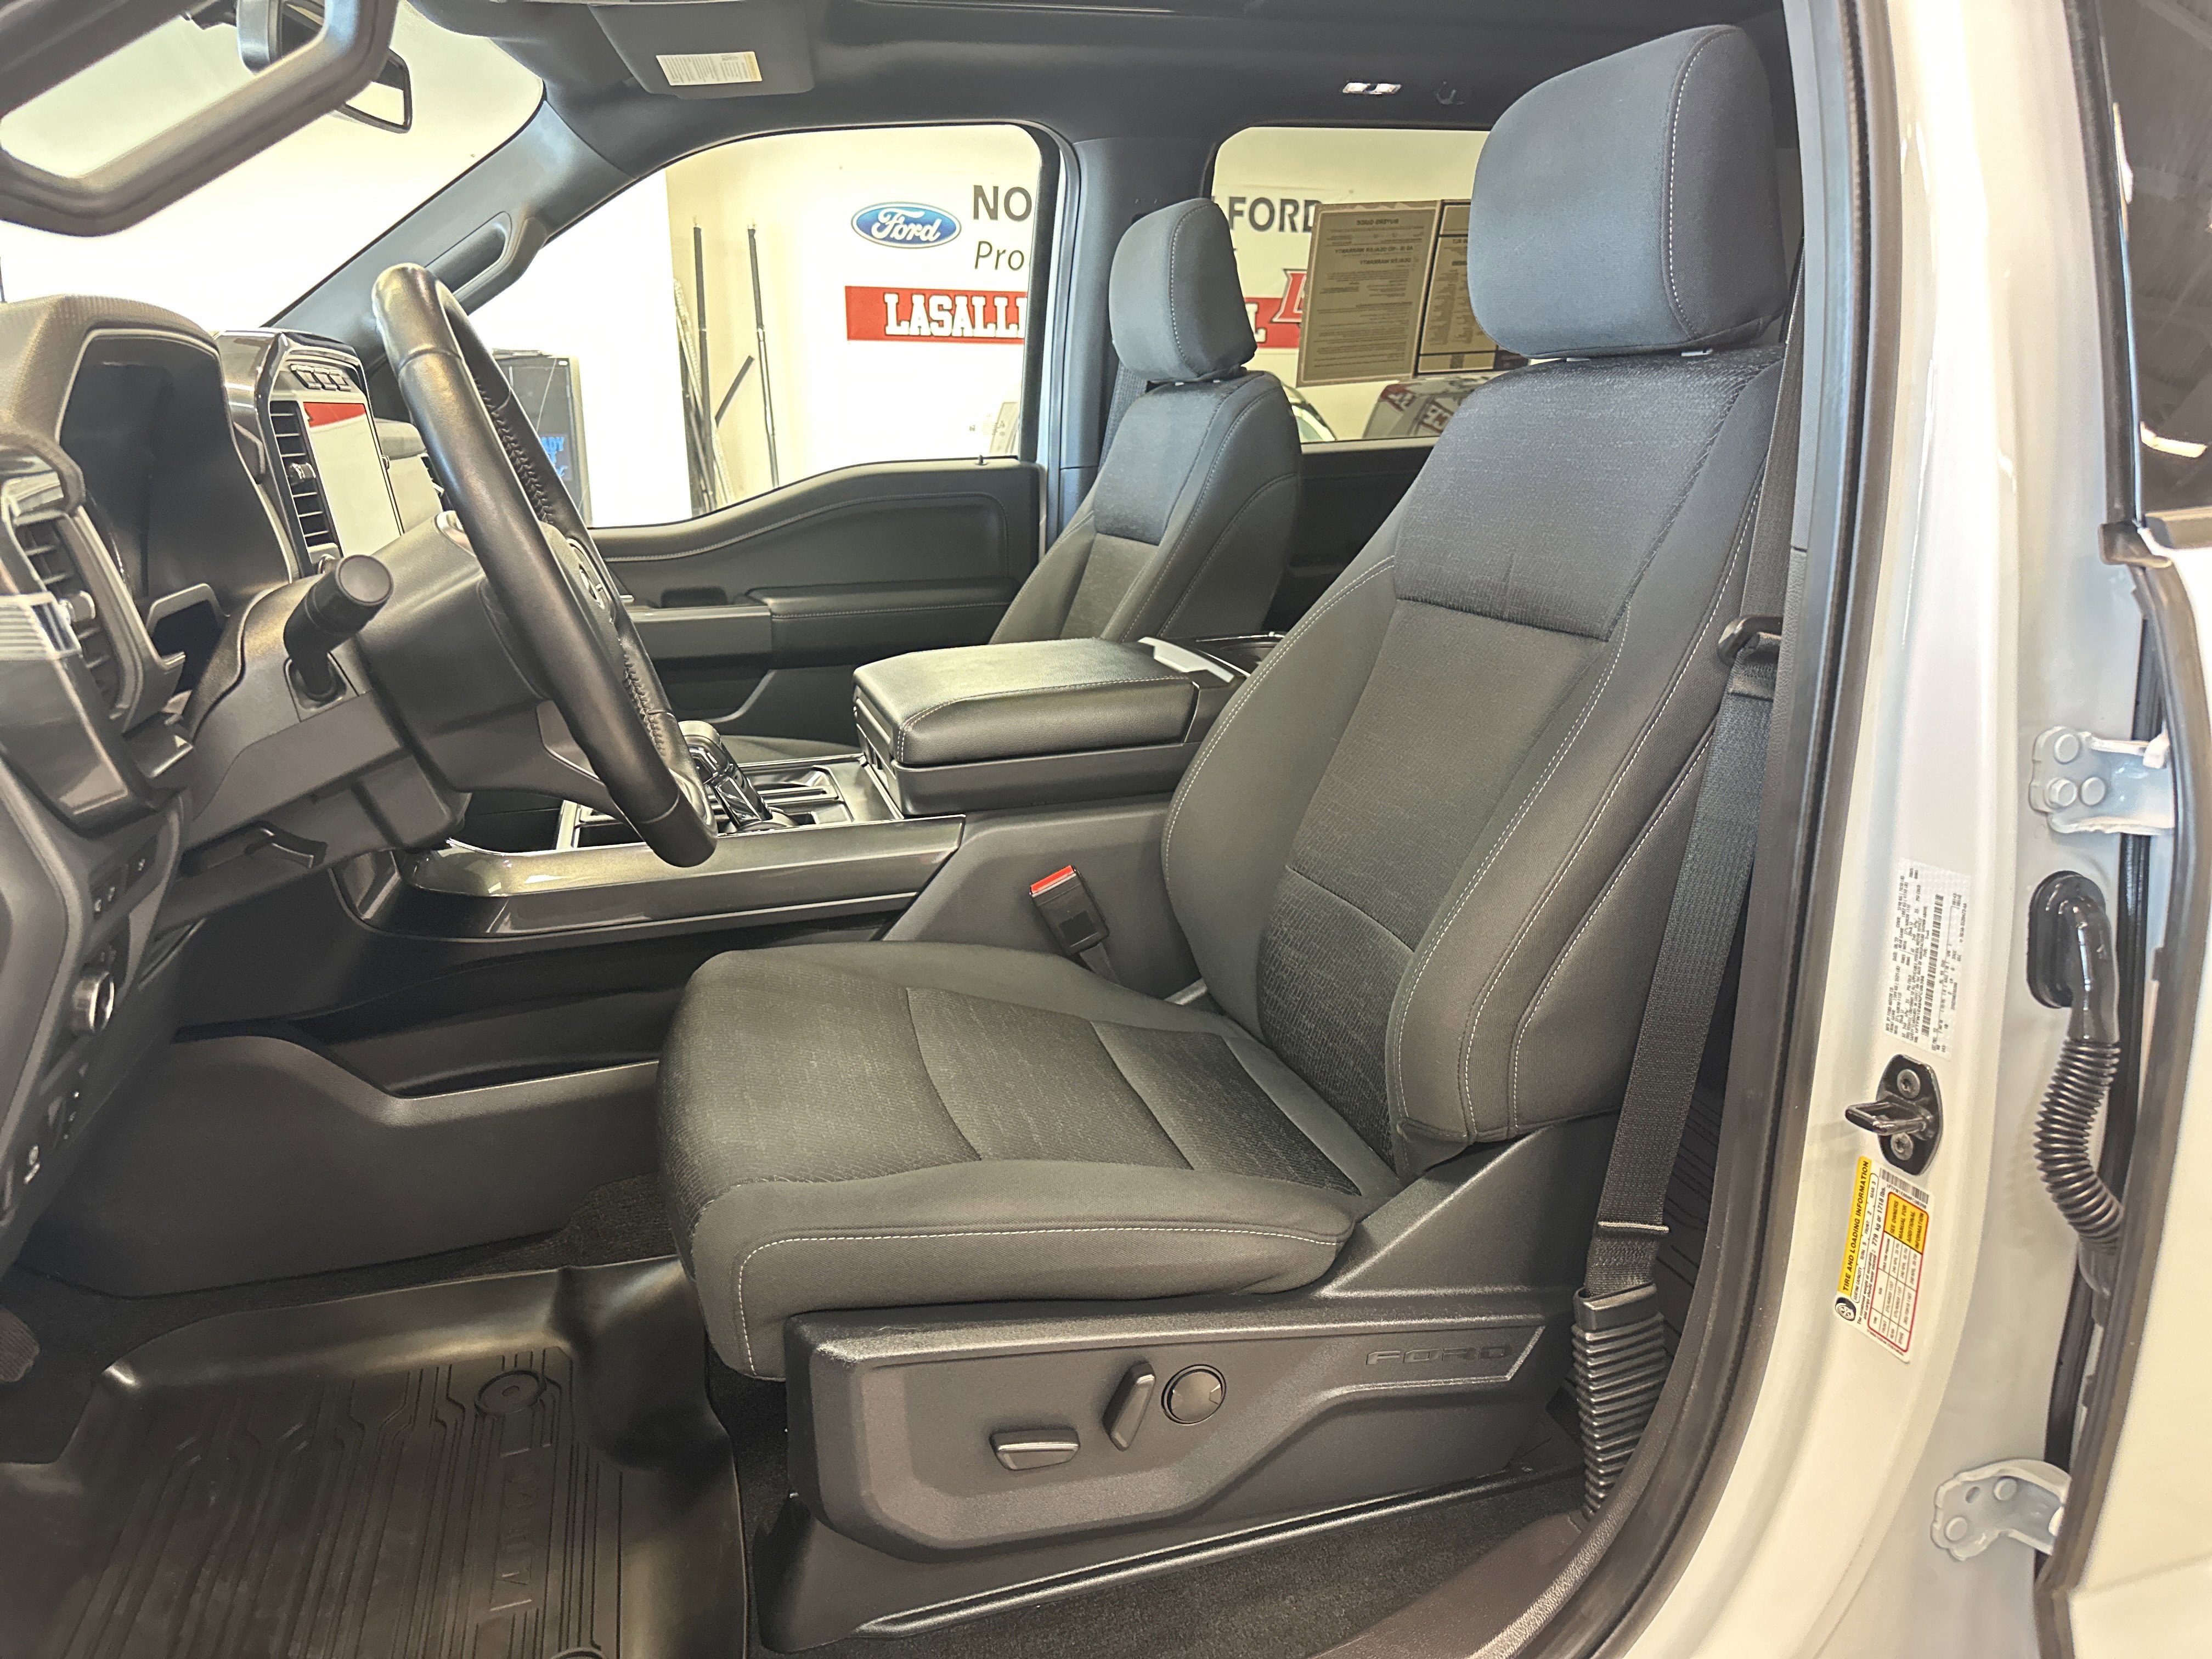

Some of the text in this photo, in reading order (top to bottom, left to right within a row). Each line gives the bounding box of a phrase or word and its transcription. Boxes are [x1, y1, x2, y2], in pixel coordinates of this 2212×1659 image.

[871, 207, 941, 243] Ford
[1842, 1160, 1869, 1293] TIRE AND LOADING INFORMATION
[1874, 1222, 1881, 1232] kg
[1877, 1214, 1881, 1222] or
[1365, 1345, 1512, 1365] FORD
